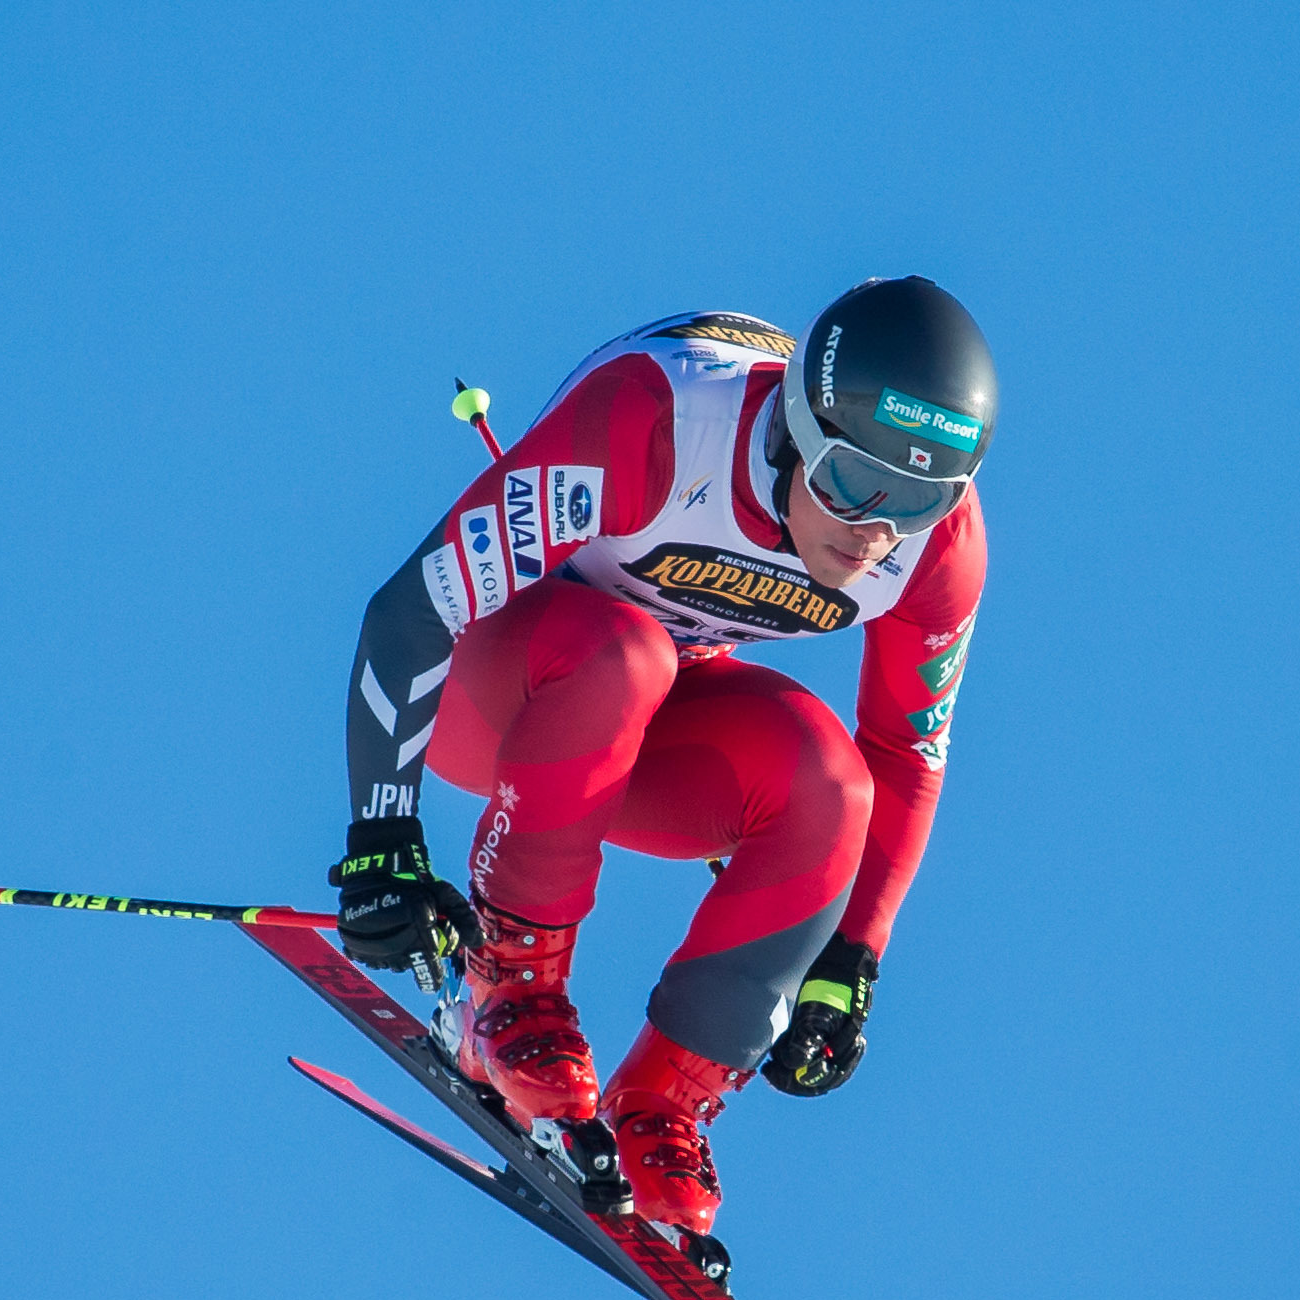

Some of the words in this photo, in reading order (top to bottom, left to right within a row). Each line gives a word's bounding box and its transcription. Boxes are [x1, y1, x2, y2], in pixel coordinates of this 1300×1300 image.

[822, 324, 843, 409] ATOMIC
[884, 396, 931, 425] Smile
[932, 413, 980, 440] Resort
[507, 475, 537, 555] ANA
[554, 470, 565, 541] SUBARU
[715, 553, 775, 575] PREMIUM
[776, 570, 811, 588] CIDER
[643, 555, 843, 630] KOPPARBERG
[680, 596, 780, 627] ALCOHOL-FREE
[362, 783, 414, 820] JPN
[342, 854, 385, 876] LEKI
[411, 844, 427, 874] LEKI
[52, 892, 132, 912] LEKI
[345, 898, 378, 922] Vertical
[381, 894, 401, 908] Cut
[856, 976, 867, 1009] LEKI
